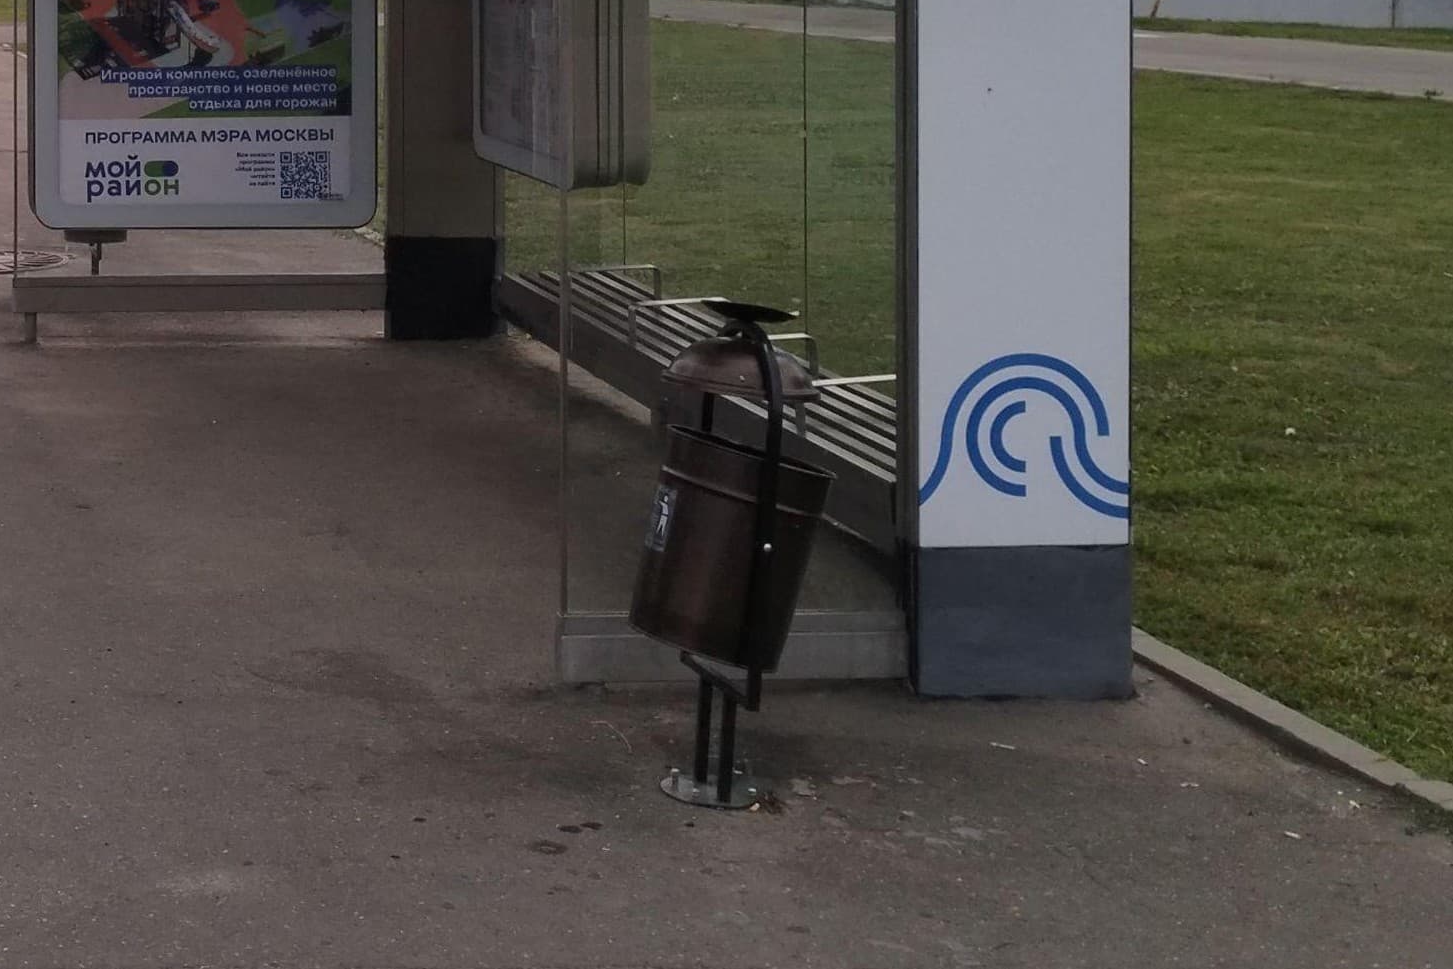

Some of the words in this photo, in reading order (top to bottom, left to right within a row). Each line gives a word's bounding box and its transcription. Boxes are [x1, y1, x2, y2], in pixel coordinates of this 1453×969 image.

[101, 68, 163, 83] Игровой
[167, 70, 240, 81] комплекс,
[243, 66, 337, 78] озеленённое
[129, 84, 230, 96] пространство
[234, 84, 243, 94] и
[247, 83, 289, 94] новое
[292, 83, 337, 92] место
[189, 98, 241, 110] отдыха
[245, 98, 271, 110] для
[275, 97, 337, 109] горожан
[85, 131, 197, 145] ПРОГРАММА
[201, 130, 251, 143] МЭРА
[256, 128, 335, 142] МОСКВЫ
